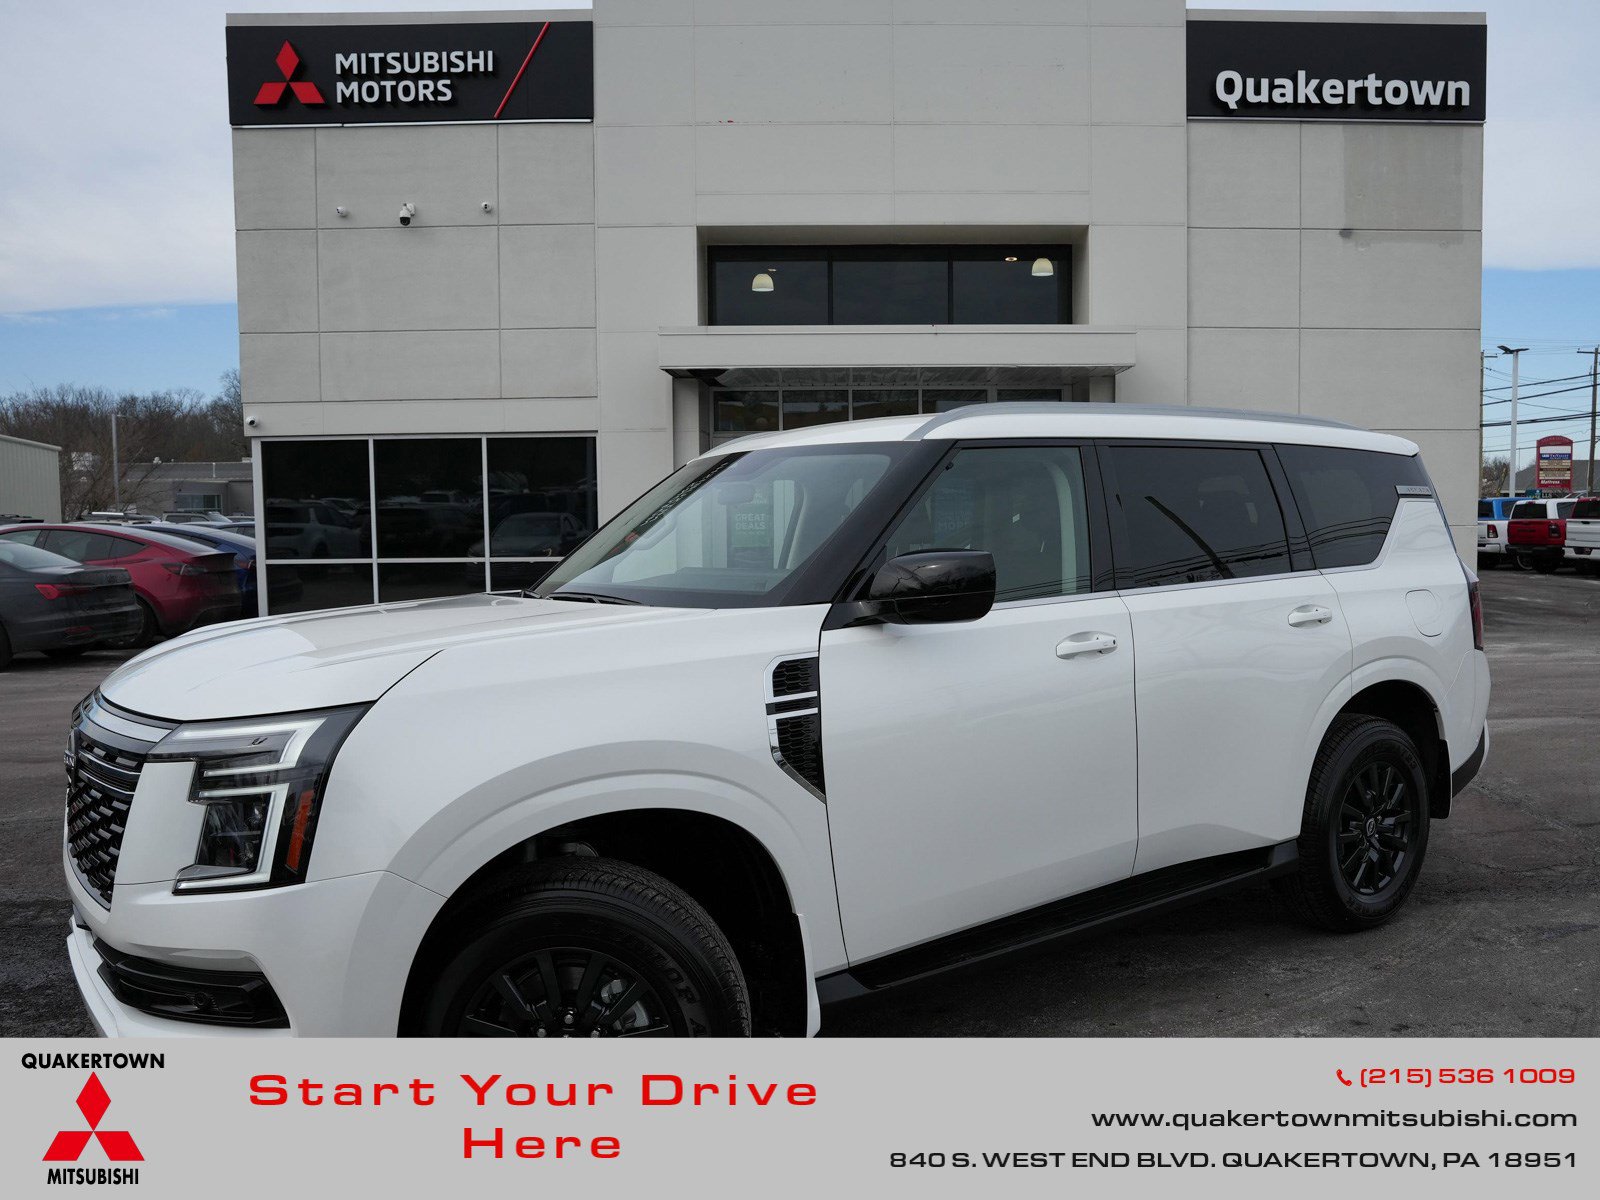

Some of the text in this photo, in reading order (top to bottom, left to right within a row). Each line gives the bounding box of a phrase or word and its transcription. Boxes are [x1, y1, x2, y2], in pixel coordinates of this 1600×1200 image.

[335, 50, 494, 75] MITSUBISHI
[336, 79, 453, 104] MOTORS
[1215, 70, 1471, 110] Quakertown
[735, 513, 766, 521] GREAT
